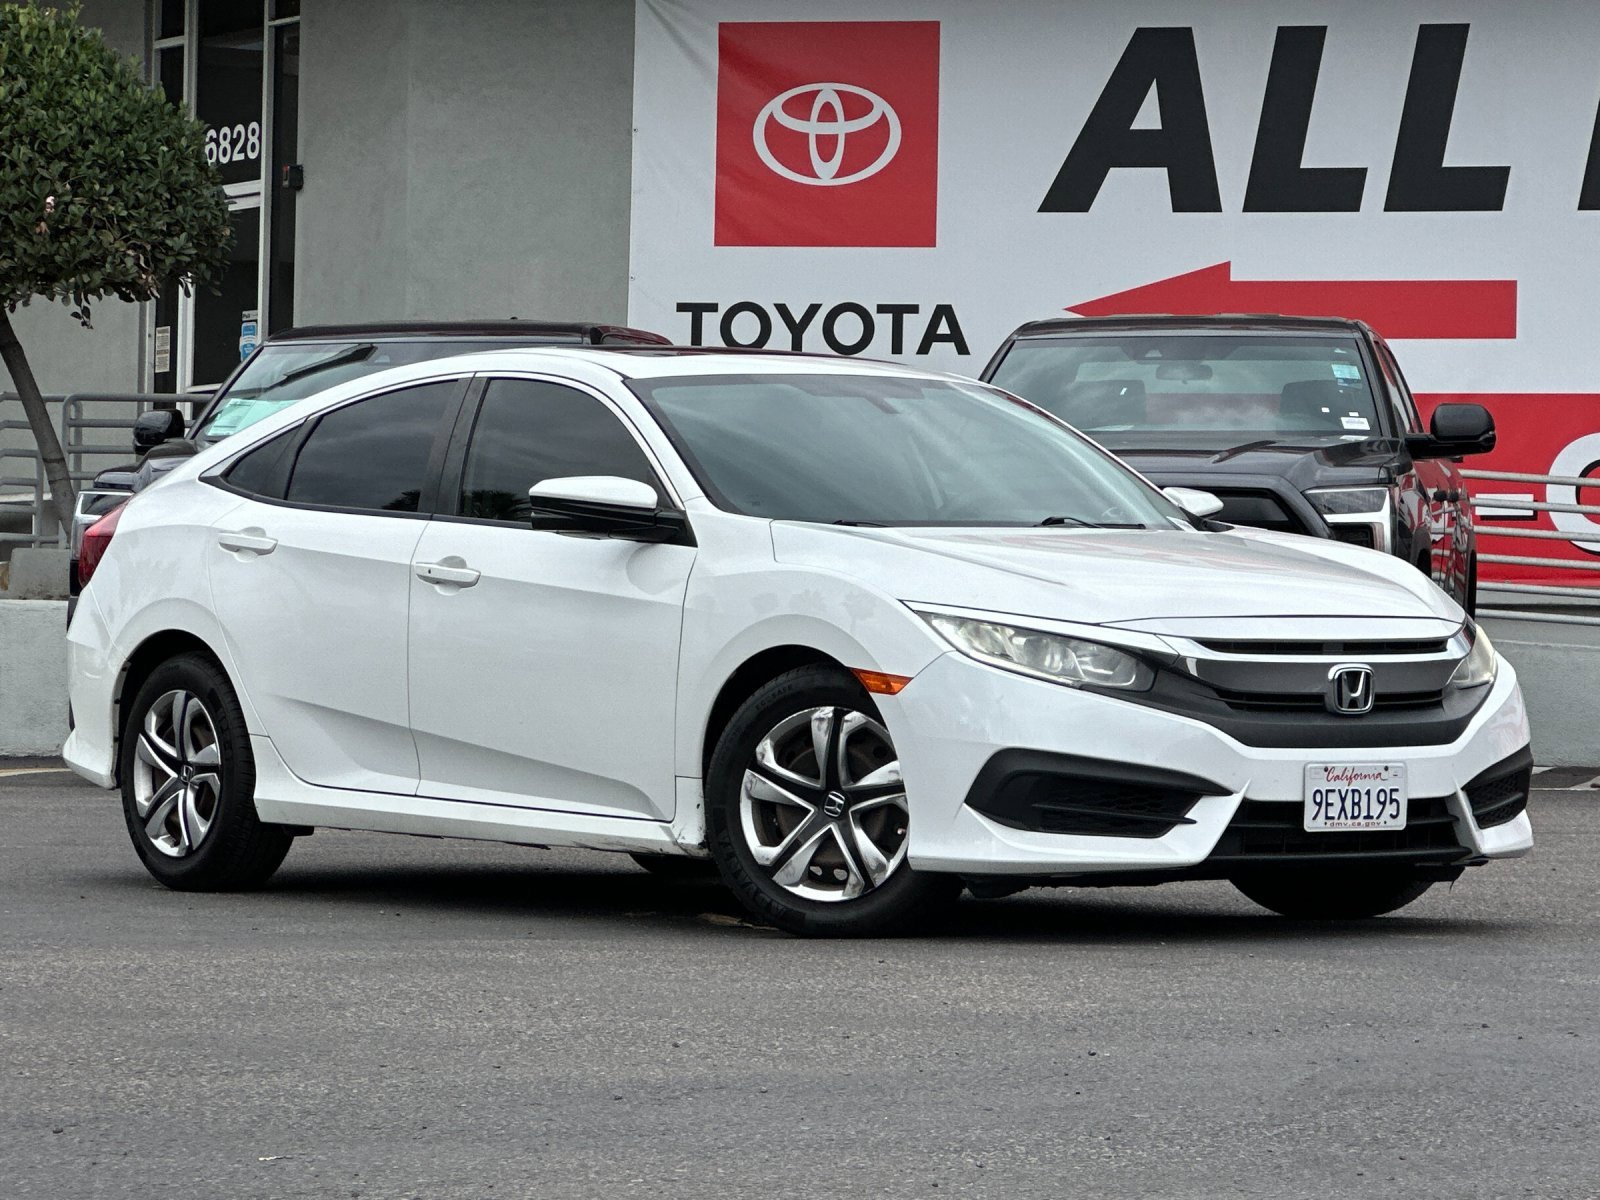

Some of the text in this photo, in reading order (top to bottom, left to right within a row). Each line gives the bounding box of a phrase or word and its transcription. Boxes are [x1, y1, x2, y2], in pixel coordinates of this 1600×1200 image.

[1037, 23, 1511, 212] ALL
[204, 121, 260, 166] 6828
[676, 301, 971, 355] TOYOTA
[1325, 766, 1388, 786] California
[1312, 788, 1400, 820] 9EXB195
